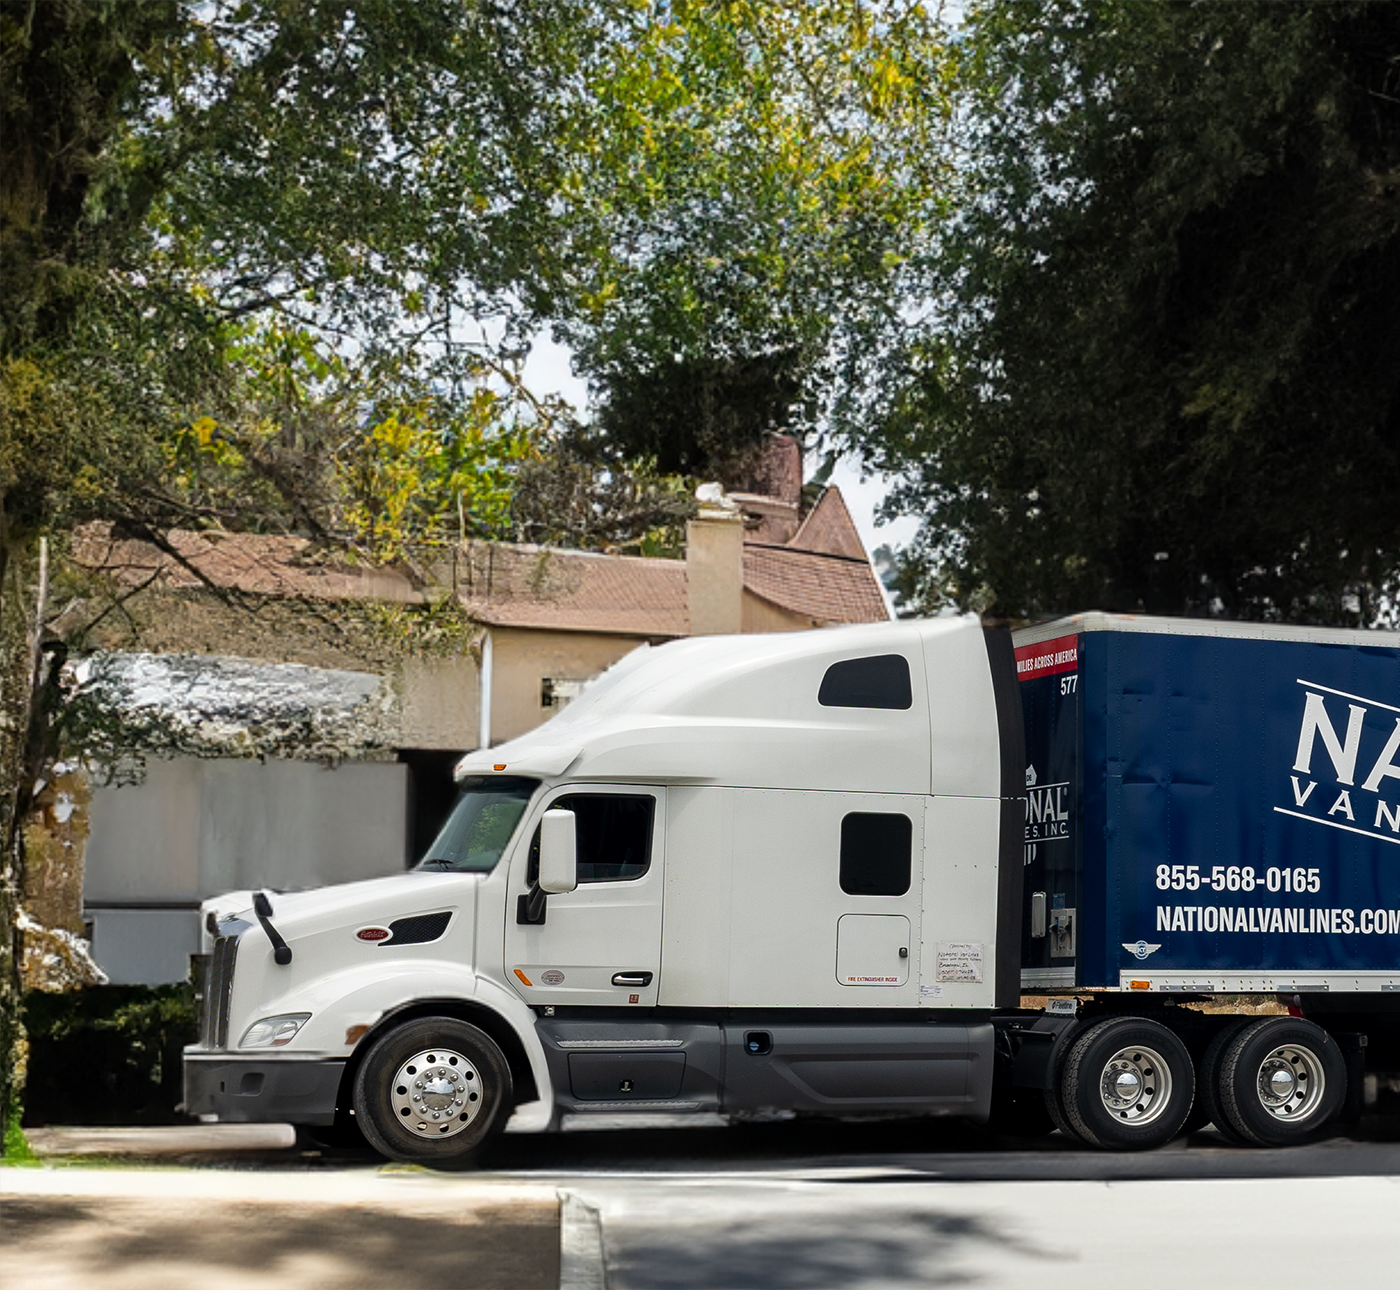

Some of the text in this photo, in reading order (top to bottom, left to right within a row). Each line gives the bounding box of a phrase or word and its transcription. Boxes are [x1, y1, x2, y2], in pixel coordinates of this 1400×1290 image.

[1034, 653, 1053, 669] ACROSS
[1055, 648, 1077, 665] AMERICA
[1060, 674, 1078, 695] 577
[1155, 864, 1321, 893] 855-568-0165
